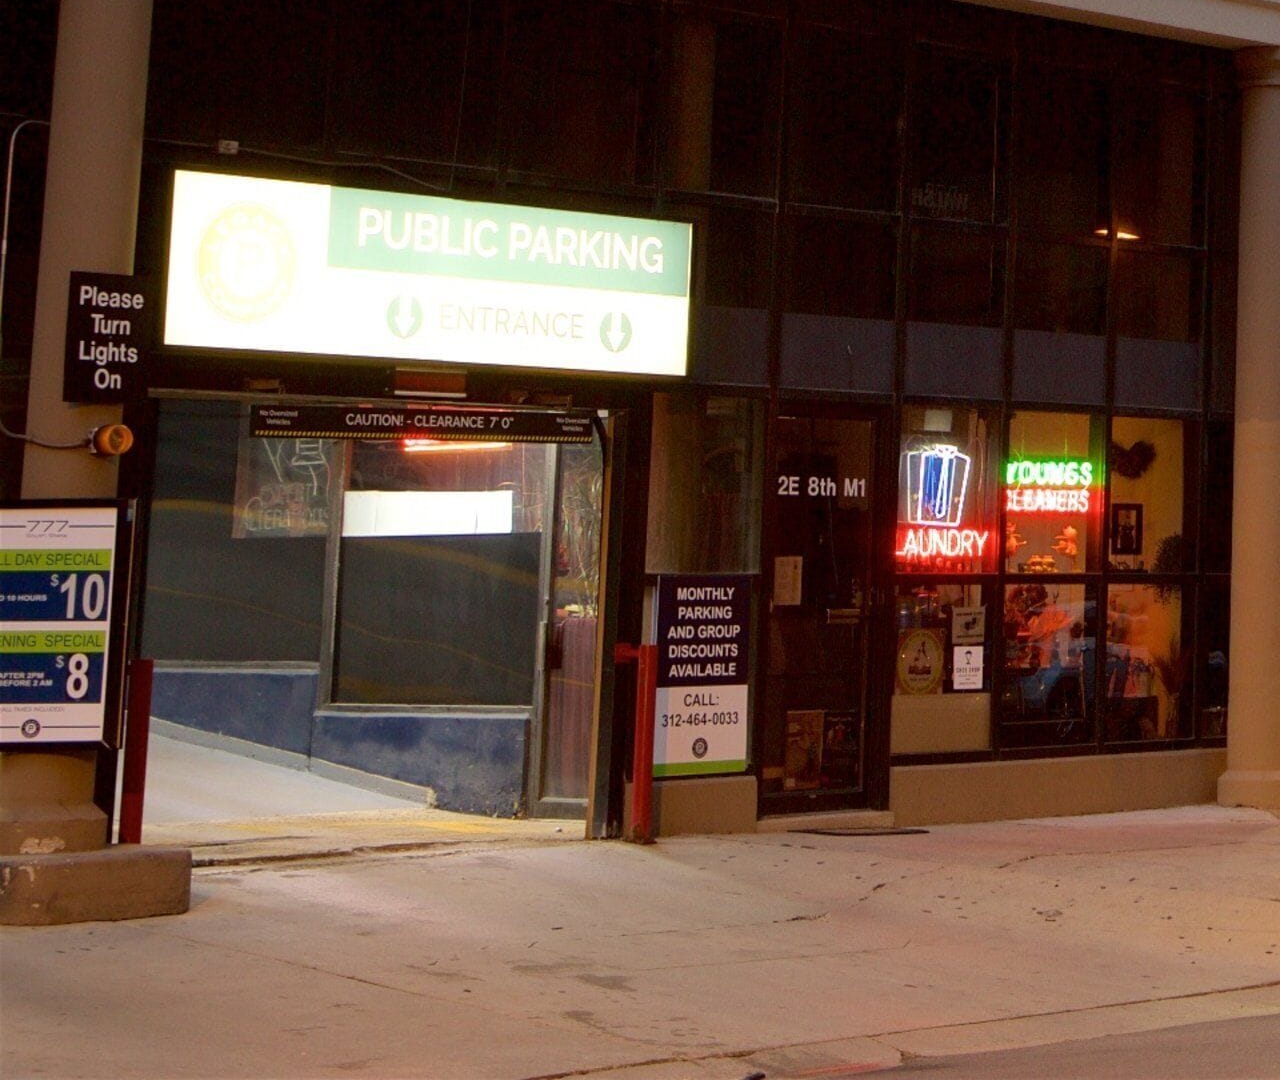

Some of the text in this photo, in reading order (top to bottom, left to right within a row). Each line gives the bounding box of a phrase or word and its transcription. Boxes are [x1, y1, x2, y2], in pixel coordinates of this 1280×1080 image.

[357, 207, 663, 273] PUBLIC PARKING
[79, 285, 144, 309] Please
[91, 313, 131, 335] Turn
[440, 304, 584, 339] ENTRANCE
[79, 340, 138, 366] Lights
[94, 368, 122, 389] On
[345, 413, 404, 427] CAUTION!
[414, 414, 484, 429] CLEARANCE
[777, 476, 867, 497] 2E 8th M1
[27, 520, 69, 532] 777
[15, 553, 42, 566] DAY
[46, 553, 103, 566] SPECIAL
[17, 594, 48, 602] HOURS
[676, 586, 735, 601] MONTHLY
[678, 606, 733, 620] PARKING
[667, 624, 741, 639] AND GROUP
[45, 634, 103, 647] SPECIAL
[668, 643, 739, 659] DISCOUNTS
[668, 662, 737, 678] AVAILABLE
[683, 693, 720, 707] CALL:
[661, 711, 740, 727] 312-464-0033
